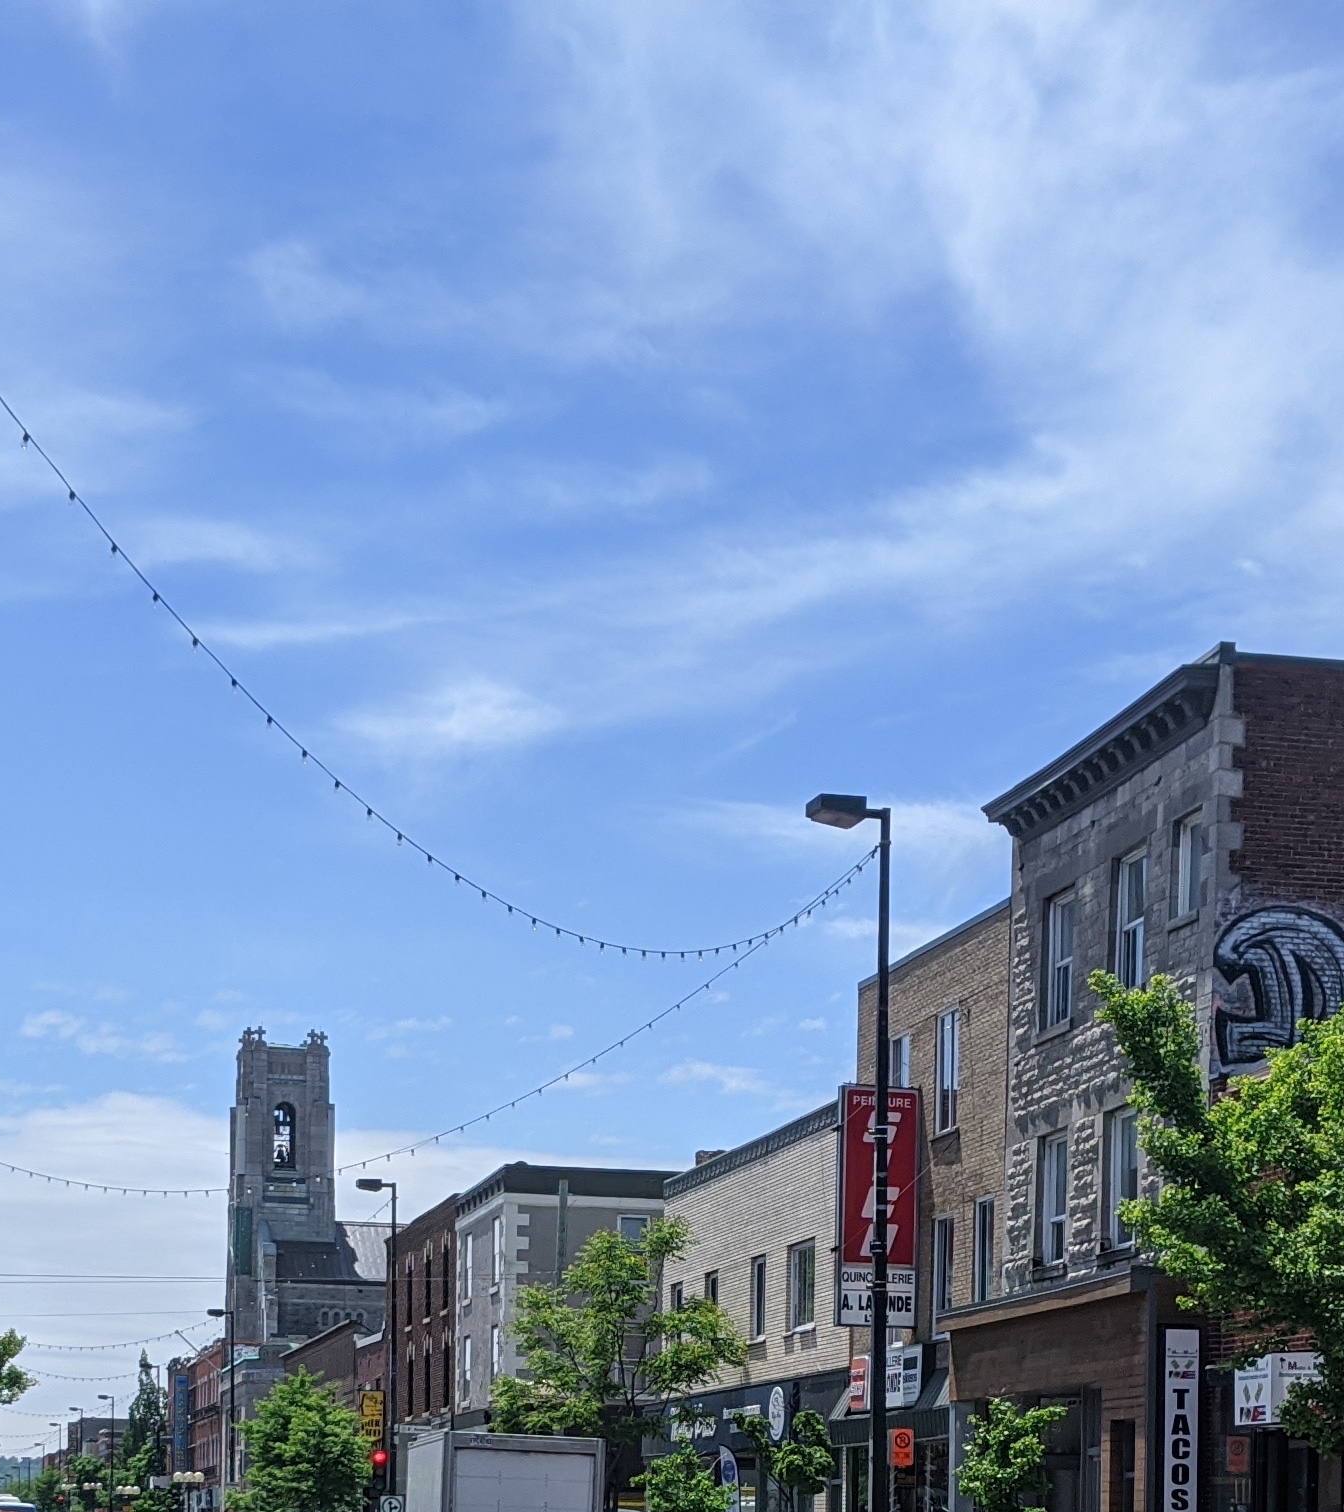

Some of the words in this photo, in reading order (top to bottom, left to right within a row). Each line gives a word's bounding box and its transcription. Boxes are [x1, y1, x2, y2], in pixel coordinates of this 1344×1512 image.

[852, 1095, 912, 1109] PEIURE
[859, 1110, 902, 1258] SCO
[841, 1271, 914, 1285] QUINCLERIE
[858, 1293, 912, 1313] LANDE
[1170, 1388, 1191, 1512] TACOS
